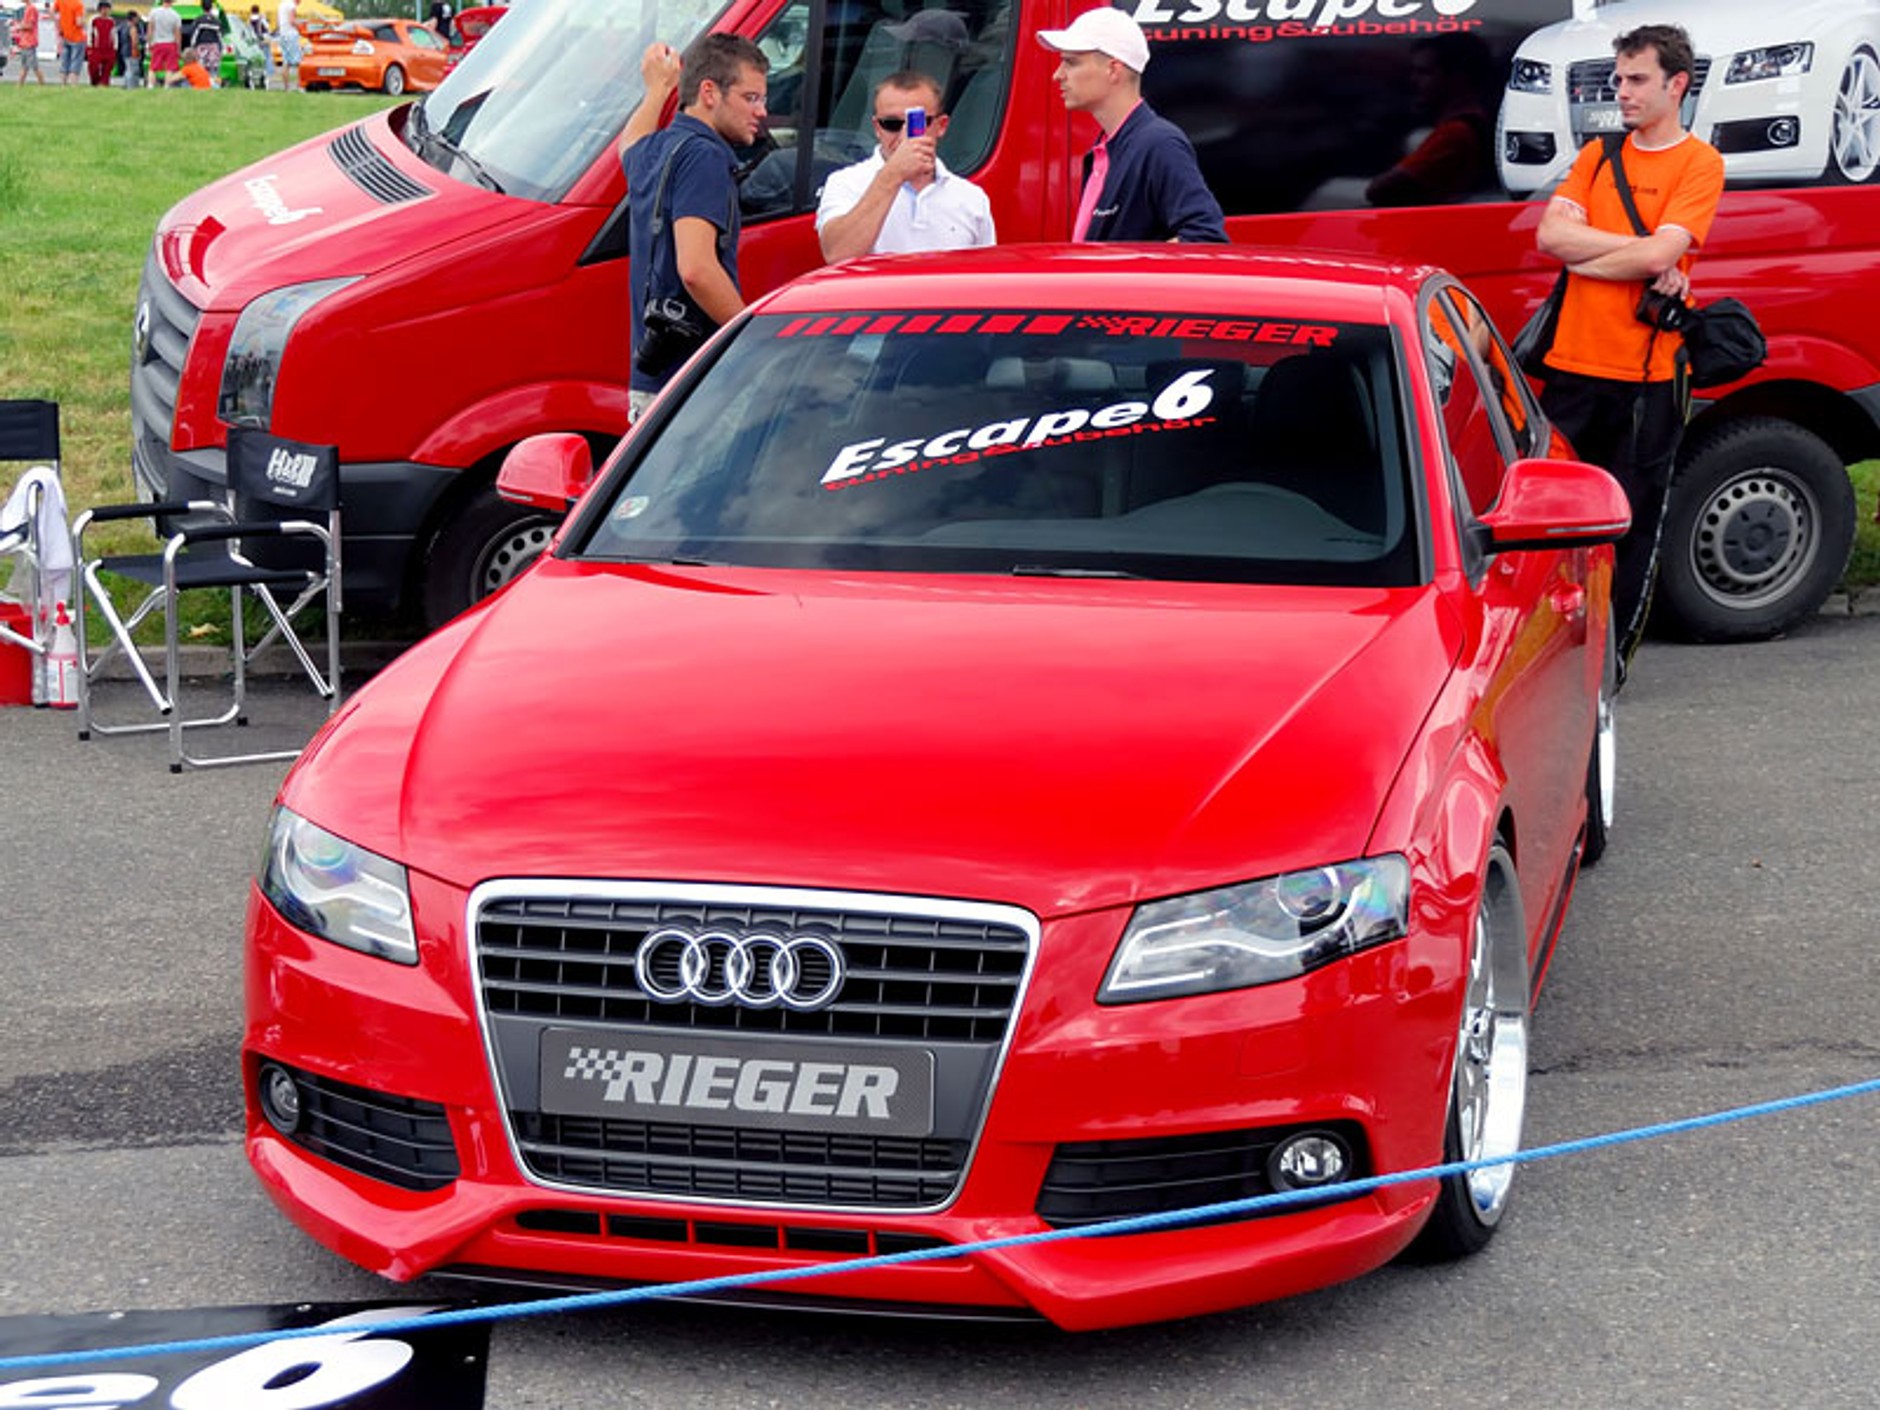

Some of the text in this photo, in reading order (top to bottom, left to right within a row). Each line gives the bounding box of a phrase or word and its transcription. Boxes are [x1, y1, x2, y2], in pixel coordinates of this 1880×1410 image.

[1106, 316, 1339, 347] RIEGER
[820, 369, 1216, 484] Escape6
[603, 1047, 899, 1120] RIEGER
